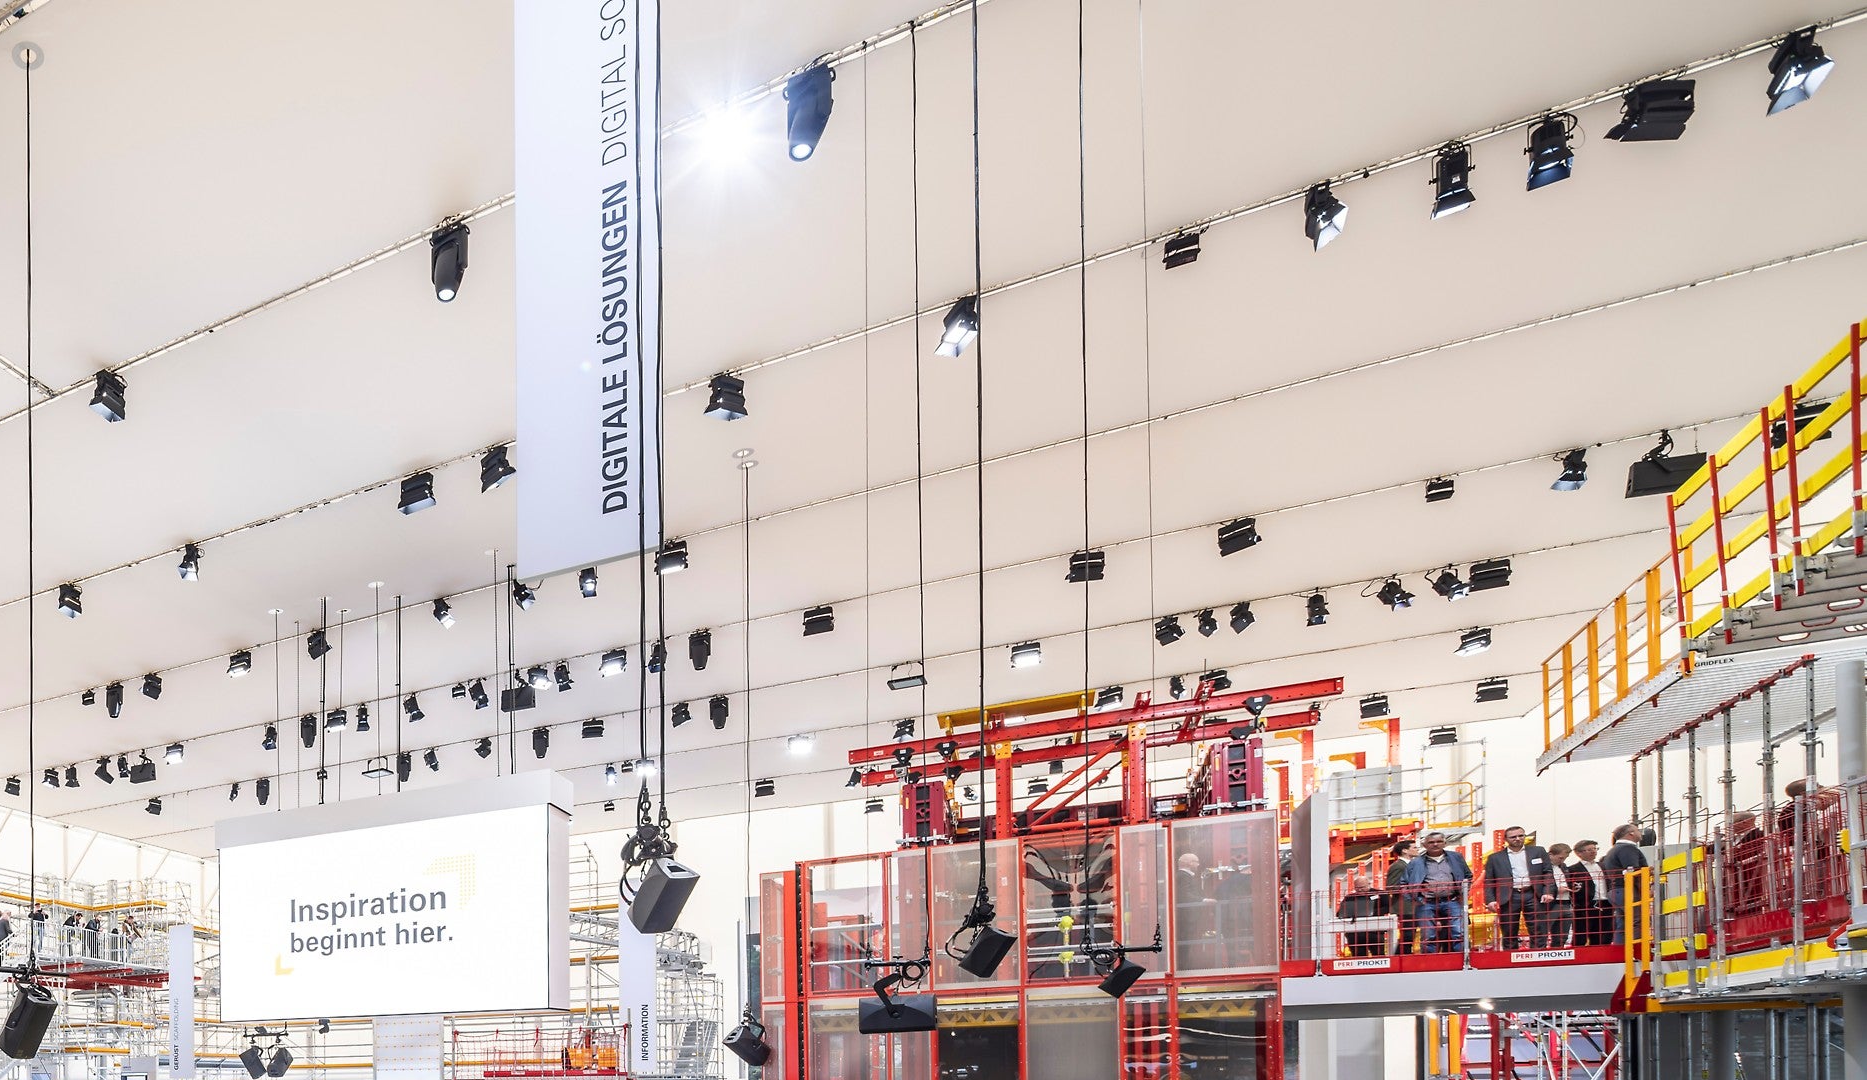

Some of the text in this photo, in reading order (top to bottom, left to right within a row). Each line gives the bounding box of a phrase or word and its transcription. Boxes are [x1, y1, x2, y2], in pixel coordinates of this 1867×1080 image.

[600, 45, 627, 166] DIGITAL
[596, 180, 627, 357] LÖSUNGEN
[601, 369, 627, 515] DIGITALE
[1694, 658, 1734, 668] GRIDFLEX
[289, 887, 447, 926] Inspiration
[289, 922, 454, 956] beginnt hier.
[1516, 950, 1573, 960] PERI PROKIT
[641, 1004, 649, 1061] INFORMATION
